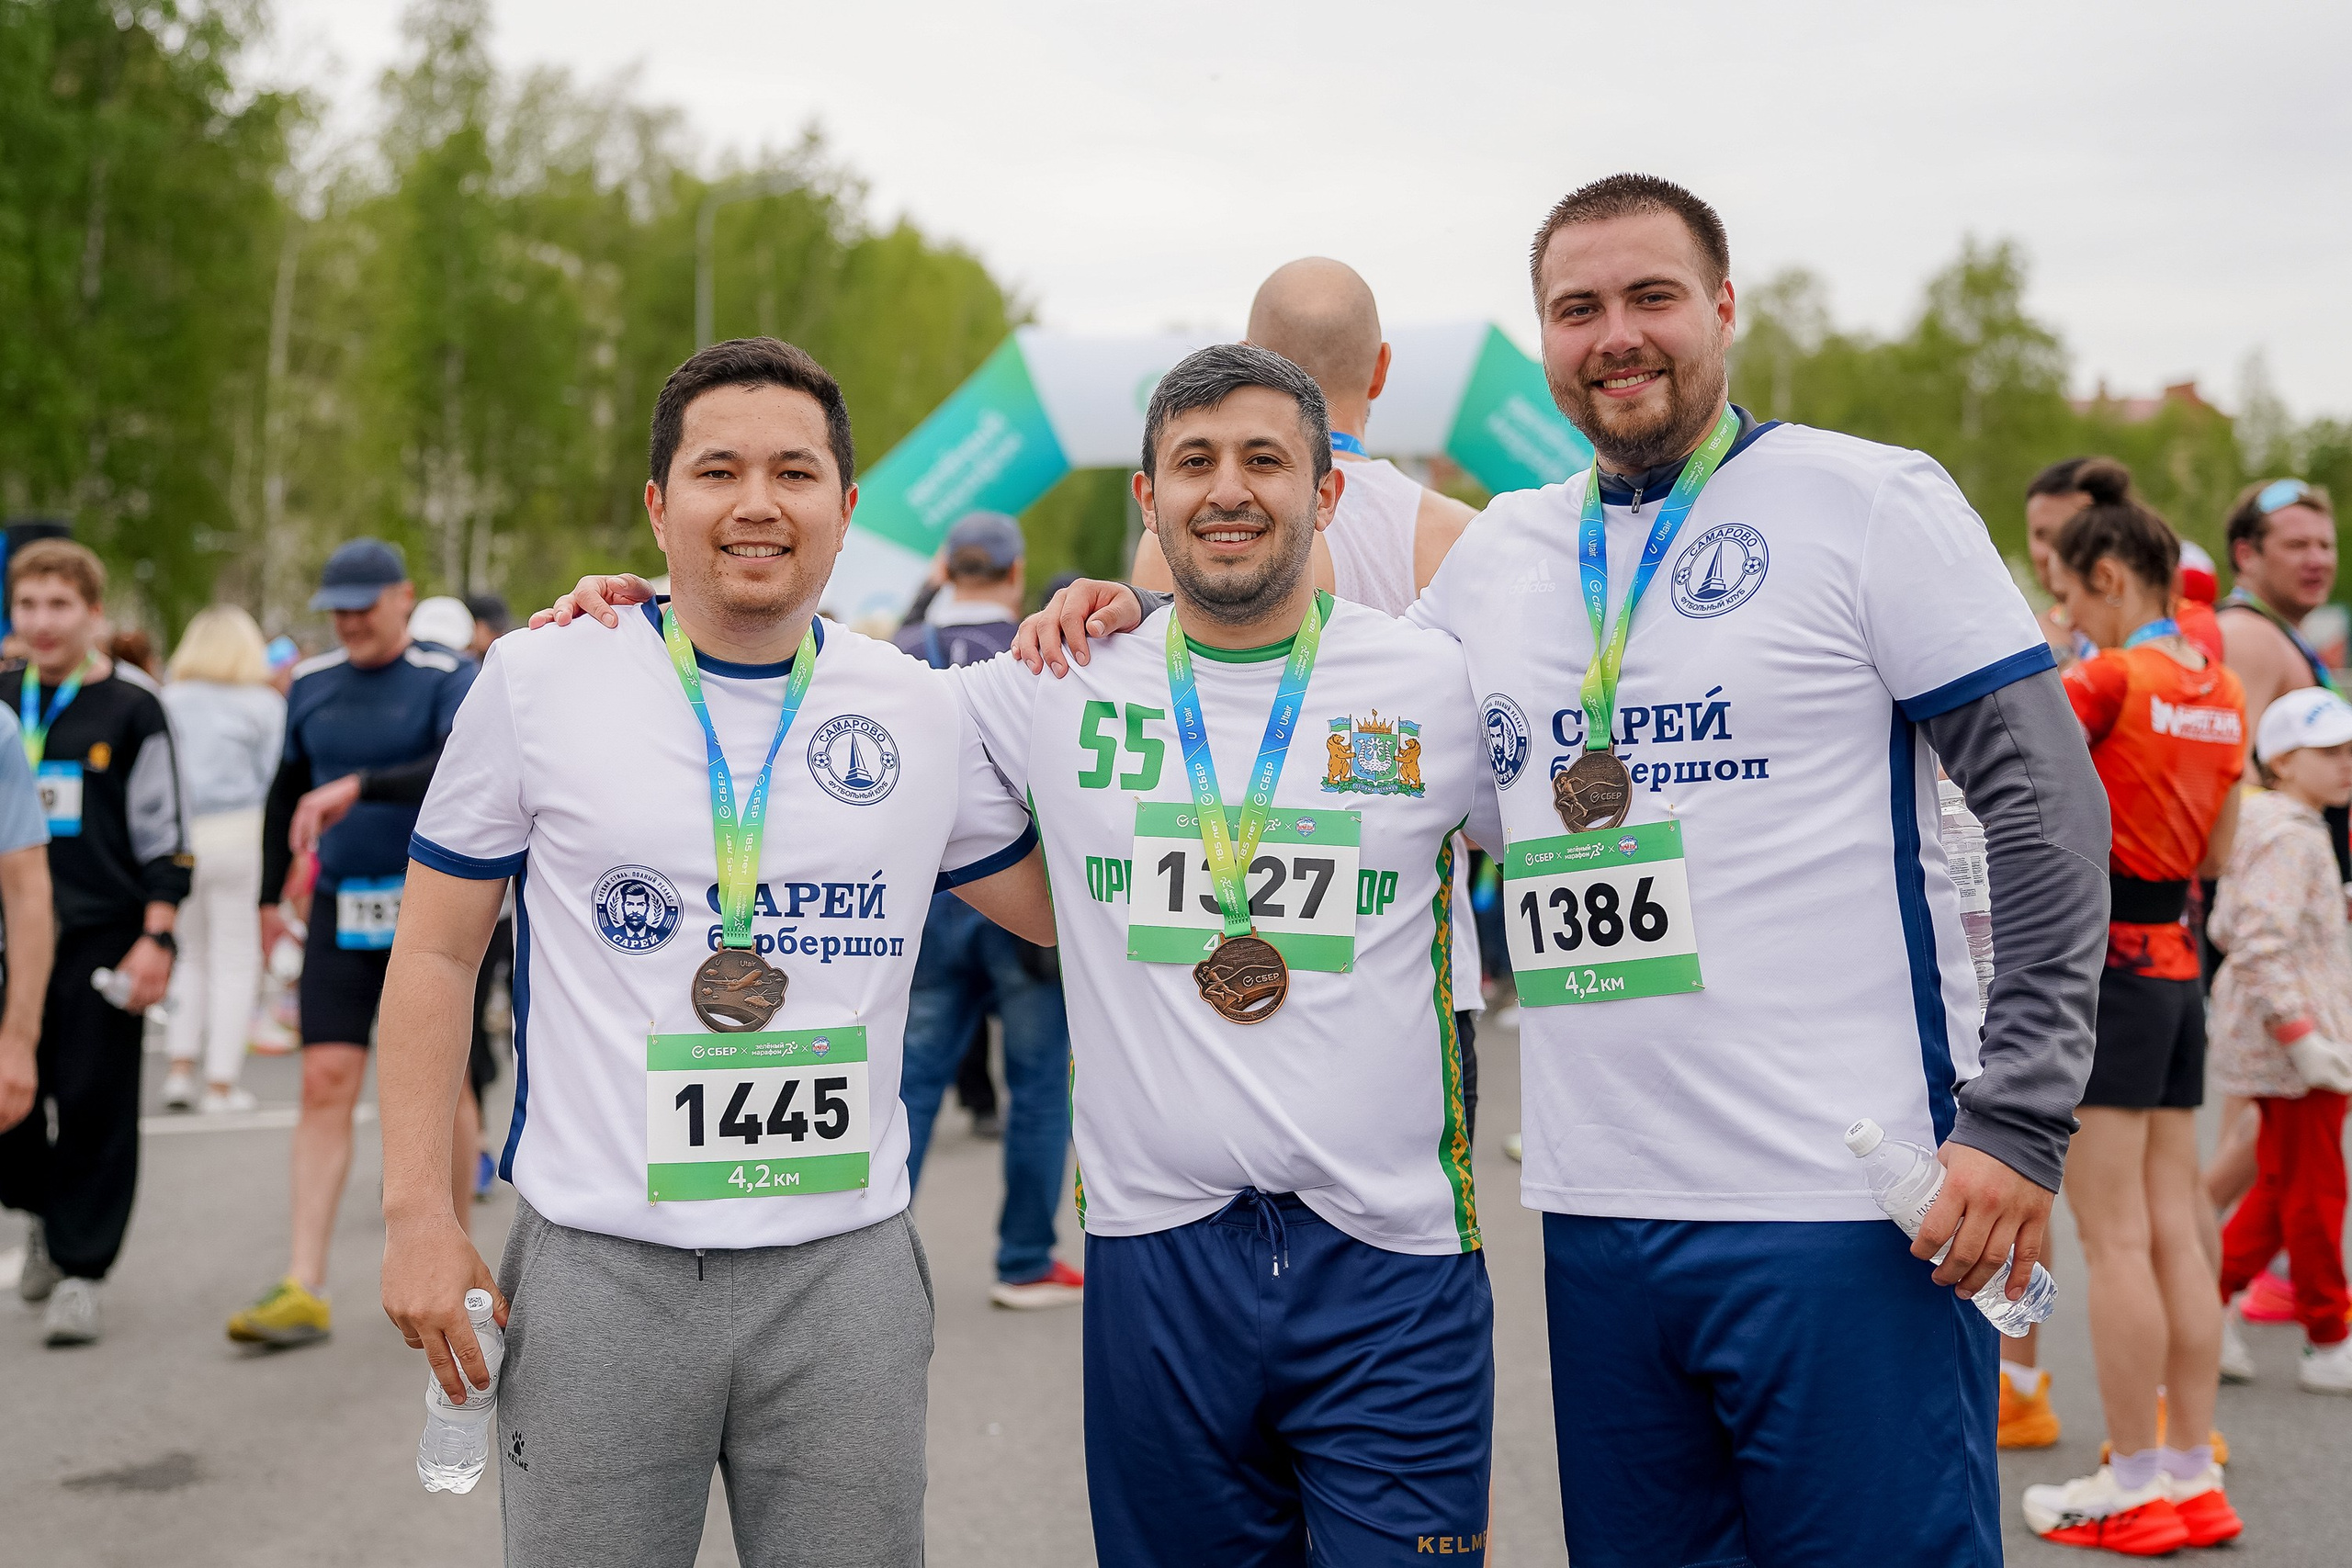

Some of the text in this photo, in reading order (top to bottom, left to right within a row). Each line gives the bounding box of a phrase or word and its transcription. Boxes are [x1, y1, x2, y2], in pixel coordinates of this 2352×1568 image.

[1656, 520, 1673, 541] Utair
[1690, 528, 1758, 557] САМАРОВО
[1588, 538, 1599, 558] Utair
[1592, 595, 1602, 622] СБЕР
[1680, 588, 1746, 612] ФУТБОЛЬНЫЙ КЛУБ
[1183, 707, 1194, 728] Utair
[1279, 704, 1294, 726] Utair
[1552, 685, 1732, 748] СРЕЙ
[819, 719, 886, 743] САМАРОВО
[1078, 700, 1165, 791] 55
[718, 771, 729, 802] СБЕР
[1195, 763, 1209, 791] СБЕР
[1260, 761, 1274, 792] СБЕР
[828, 780, 888, 799] ФУТБОЛЬНЫЙ КЛУБ
[1600, 792, 1623, 801] СБЕР
[750, 790, 761, 818] СБЕР
[744, 832, 753, 852] 185
[1210, 819, 1225, 862] 185 лет
[1239, 819, 1258, 860] 185 лет
[1534, 852, 1554, 863] СБЕР
[632, 871, 658, 883] ПОЛНЫЙ
[1521, 875, 1668, 953] 1386
[612, 931, 660, 948] САРЕЙ
[707, 924, 905, 964] брбершоп
[1255, 972, 1280, 983] СБЕР
[707, 1047, 782, 1057] СБЕР марафон
[755, 1042, 785, 1050] зелёный
[675, 1076, 850, 1147] 1445
[507, 1450, 529, 1472] KELME
